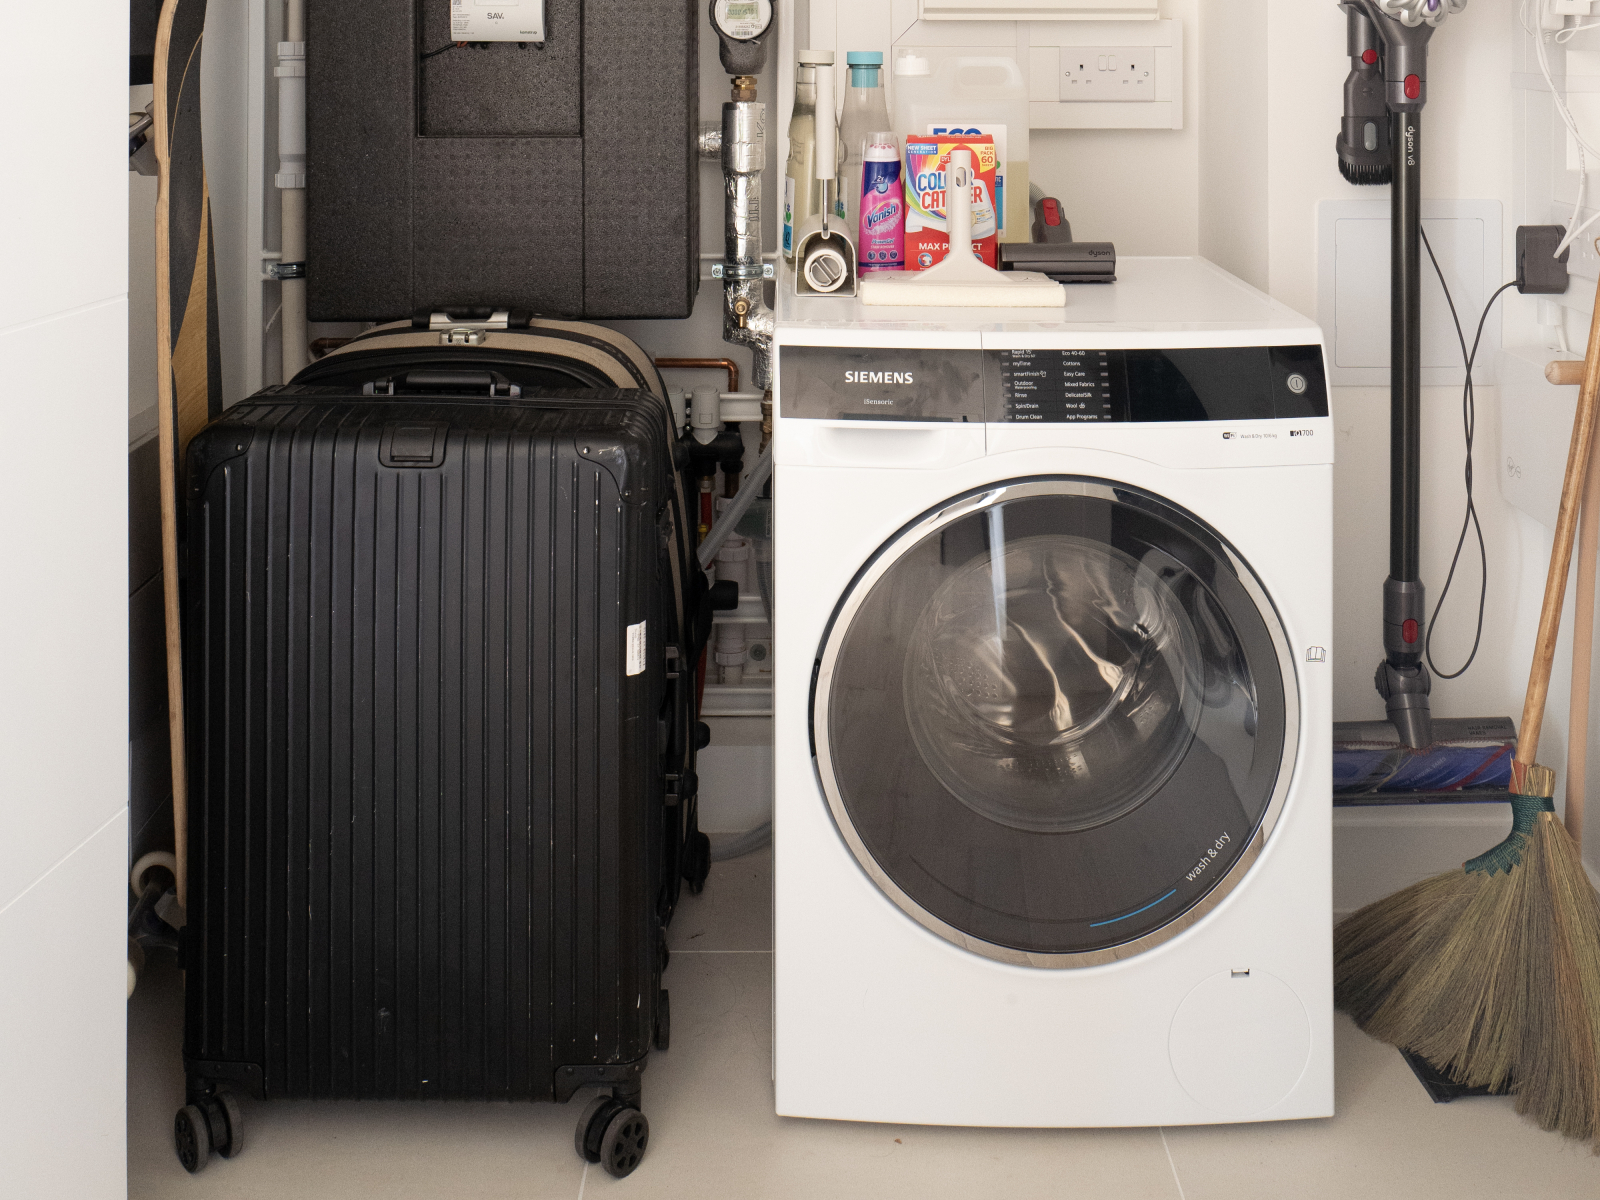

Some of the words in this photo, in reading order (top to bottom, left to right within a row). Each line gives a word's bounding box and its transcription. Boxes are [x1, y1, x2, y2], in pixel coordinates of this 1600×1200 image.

[1405, 126, 1416, 153] dyson
[867, 203, 896, 228] Vanish
[1088, 249, 1111, 257] dyson
[845, 371, 914, 384] SIEMENS
[1185, 855, 1211, 882] wash
[1207, 848, 1218, 858] &
[1215, 831, 1231, 850] dry
